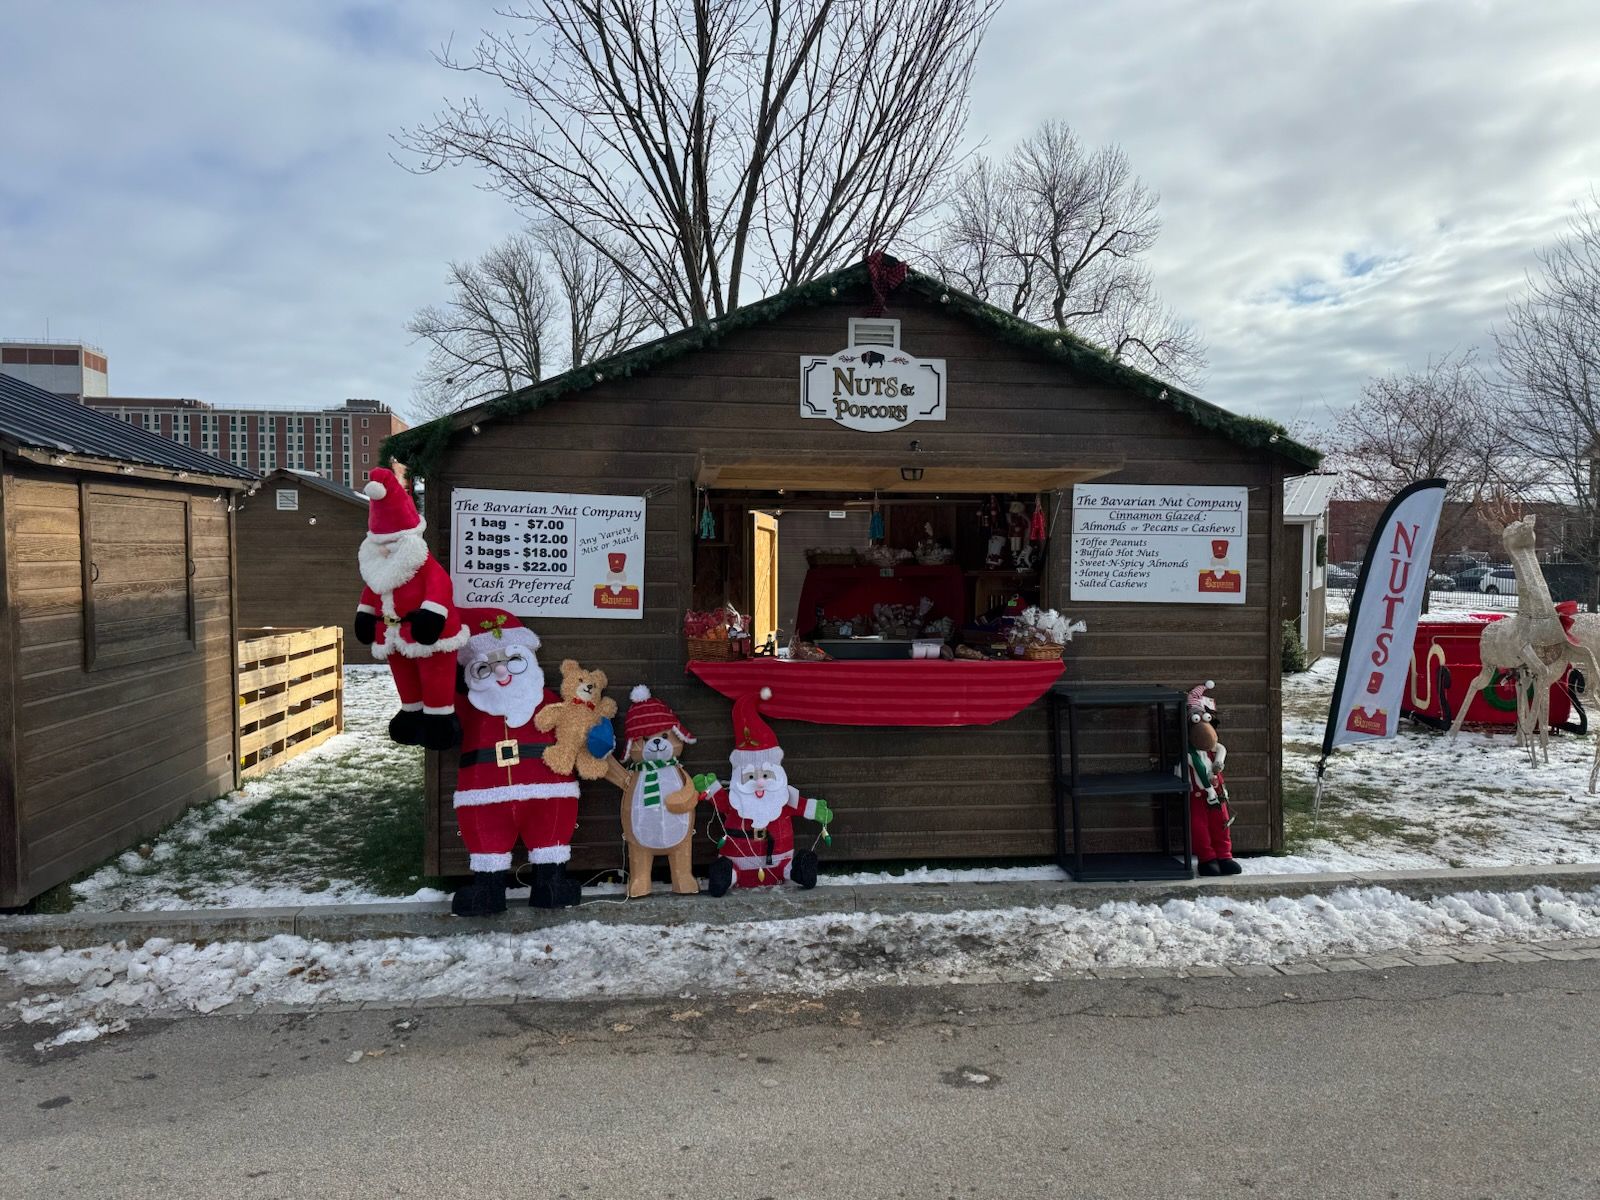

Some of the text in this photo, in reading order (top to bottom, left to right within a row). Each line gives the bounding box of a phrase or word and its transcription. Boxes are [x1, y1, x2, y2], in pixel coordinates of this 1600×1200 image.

[901, 384, 915, 396] &
[1076, 495, 1242, 512] The Bavarian Nut Company
[454, 499, 642, 522] The Bavarian Nut Company
[1109, 511, 1162, 521] Cinnamon
[470, 517, 476, 527] 1
[481, 517, 507, 530] bag
[527, 519, 564, 530] $7.00
[1080, 521, 1127, 532] Almonds
[1142, 523, 1179, 532] Pecans
[1191, 523, 1236, 533] Cashews
[465, 531, 474, 541] 2
[478, 531, 511, 544] bags
[523, 533, 568, 544] $12.00
[579, 527, 632, 547] Any Variety
[1081, 537, 1148, 549] Toffee Peanuts
[581, 532, 640, 556] Mix or Match
[465, 545, 474, 556] 3
[478, 546, 511, 559] bags
[523, 547, 568, 559] $18.00
[1080, 548, 1160, 559] Buffalo Hot Nuts
[464, 560, 473, 570] 4
[477, 560, 510, 573] bags
[522, 561, 568, 573] $22.00
[1079, 559, 1189, 570] Sweet-N-Spicy Almonds
[1079, 569, 1151, 580] Honey Cashews
[508, 578, 574, 594] Preferred
[1079, 579, 1148, 589] Salted Cashews
[466, 591, 573, 608] Cards Accepted
[1371, 520, 1421, 668] NUTS
